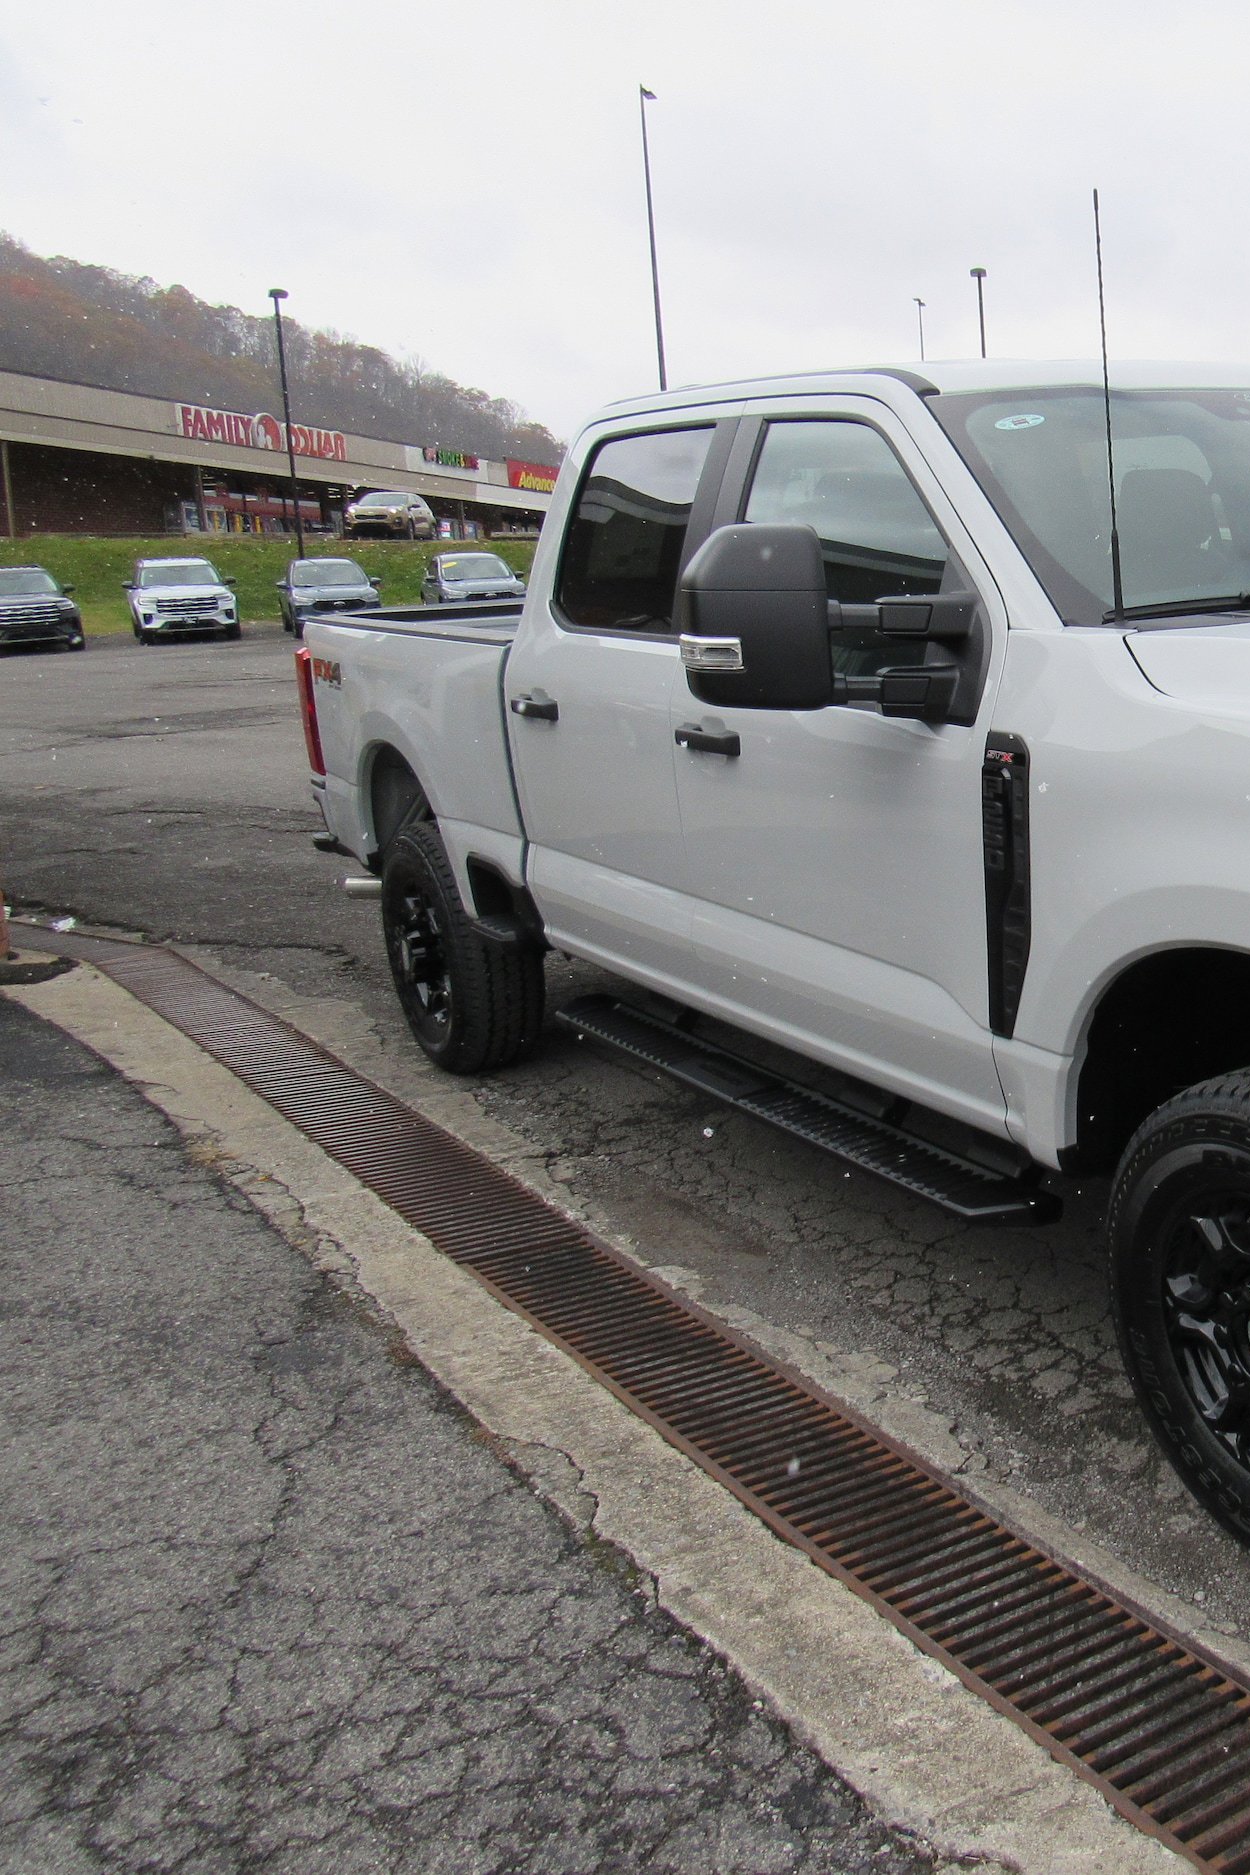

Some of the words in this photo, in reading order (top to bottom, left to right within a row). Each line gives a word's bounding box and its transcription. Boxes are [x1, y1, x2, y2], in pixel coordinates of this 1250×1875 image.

[181, 405, 252, 447] FAMILY
[312, 657, 342, 685] FX4
[986, 749, 1014, 763] STX
